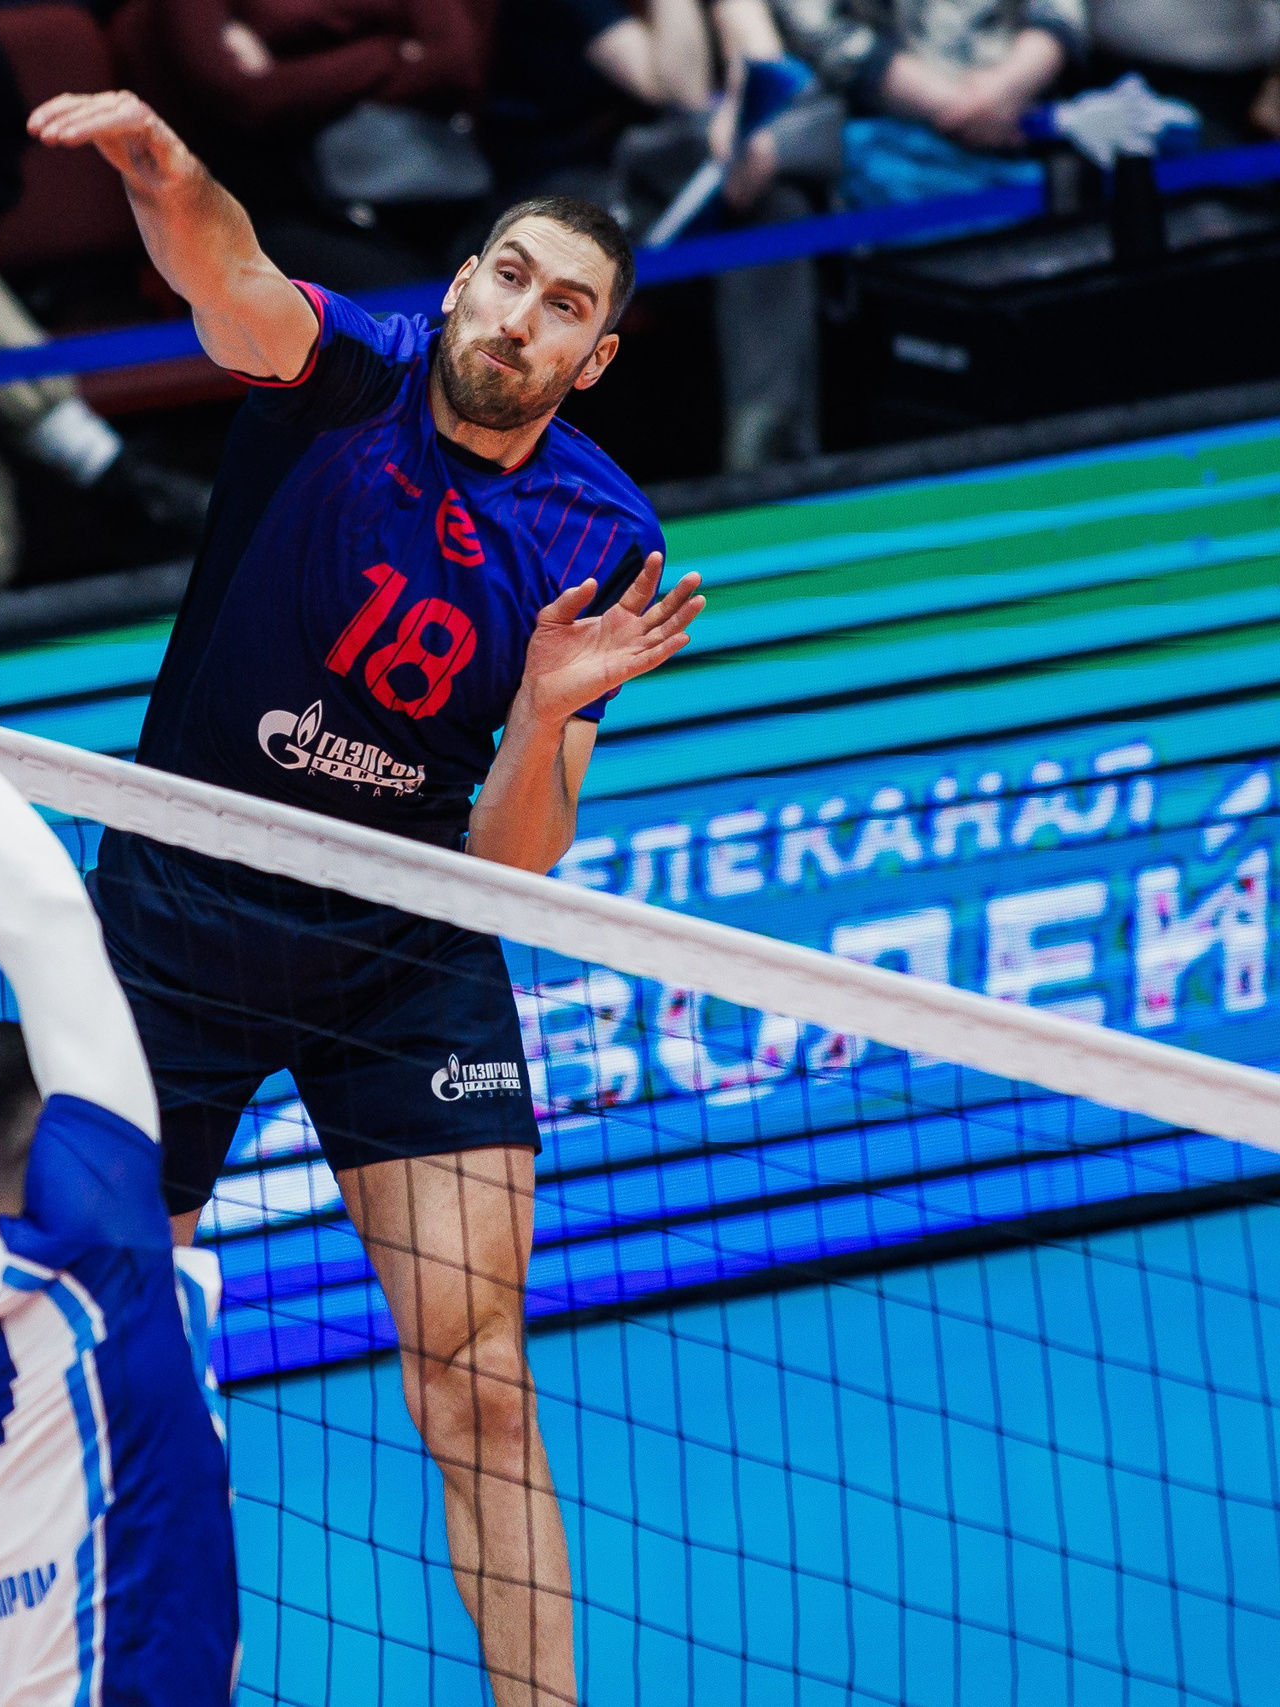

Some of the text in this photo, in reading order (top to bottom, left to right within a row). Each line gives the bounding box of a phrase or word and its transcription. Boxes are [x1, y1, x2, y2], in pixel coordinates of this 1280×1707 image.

[325, 562, 478, 720] 18
[316, 731, 426, 780] ГАЗПРОМ
[555, 742, 1155, 905] ЕЛЕКАНАЛ
[462, 1062, 519, 1081] ГАЗПРОМ
